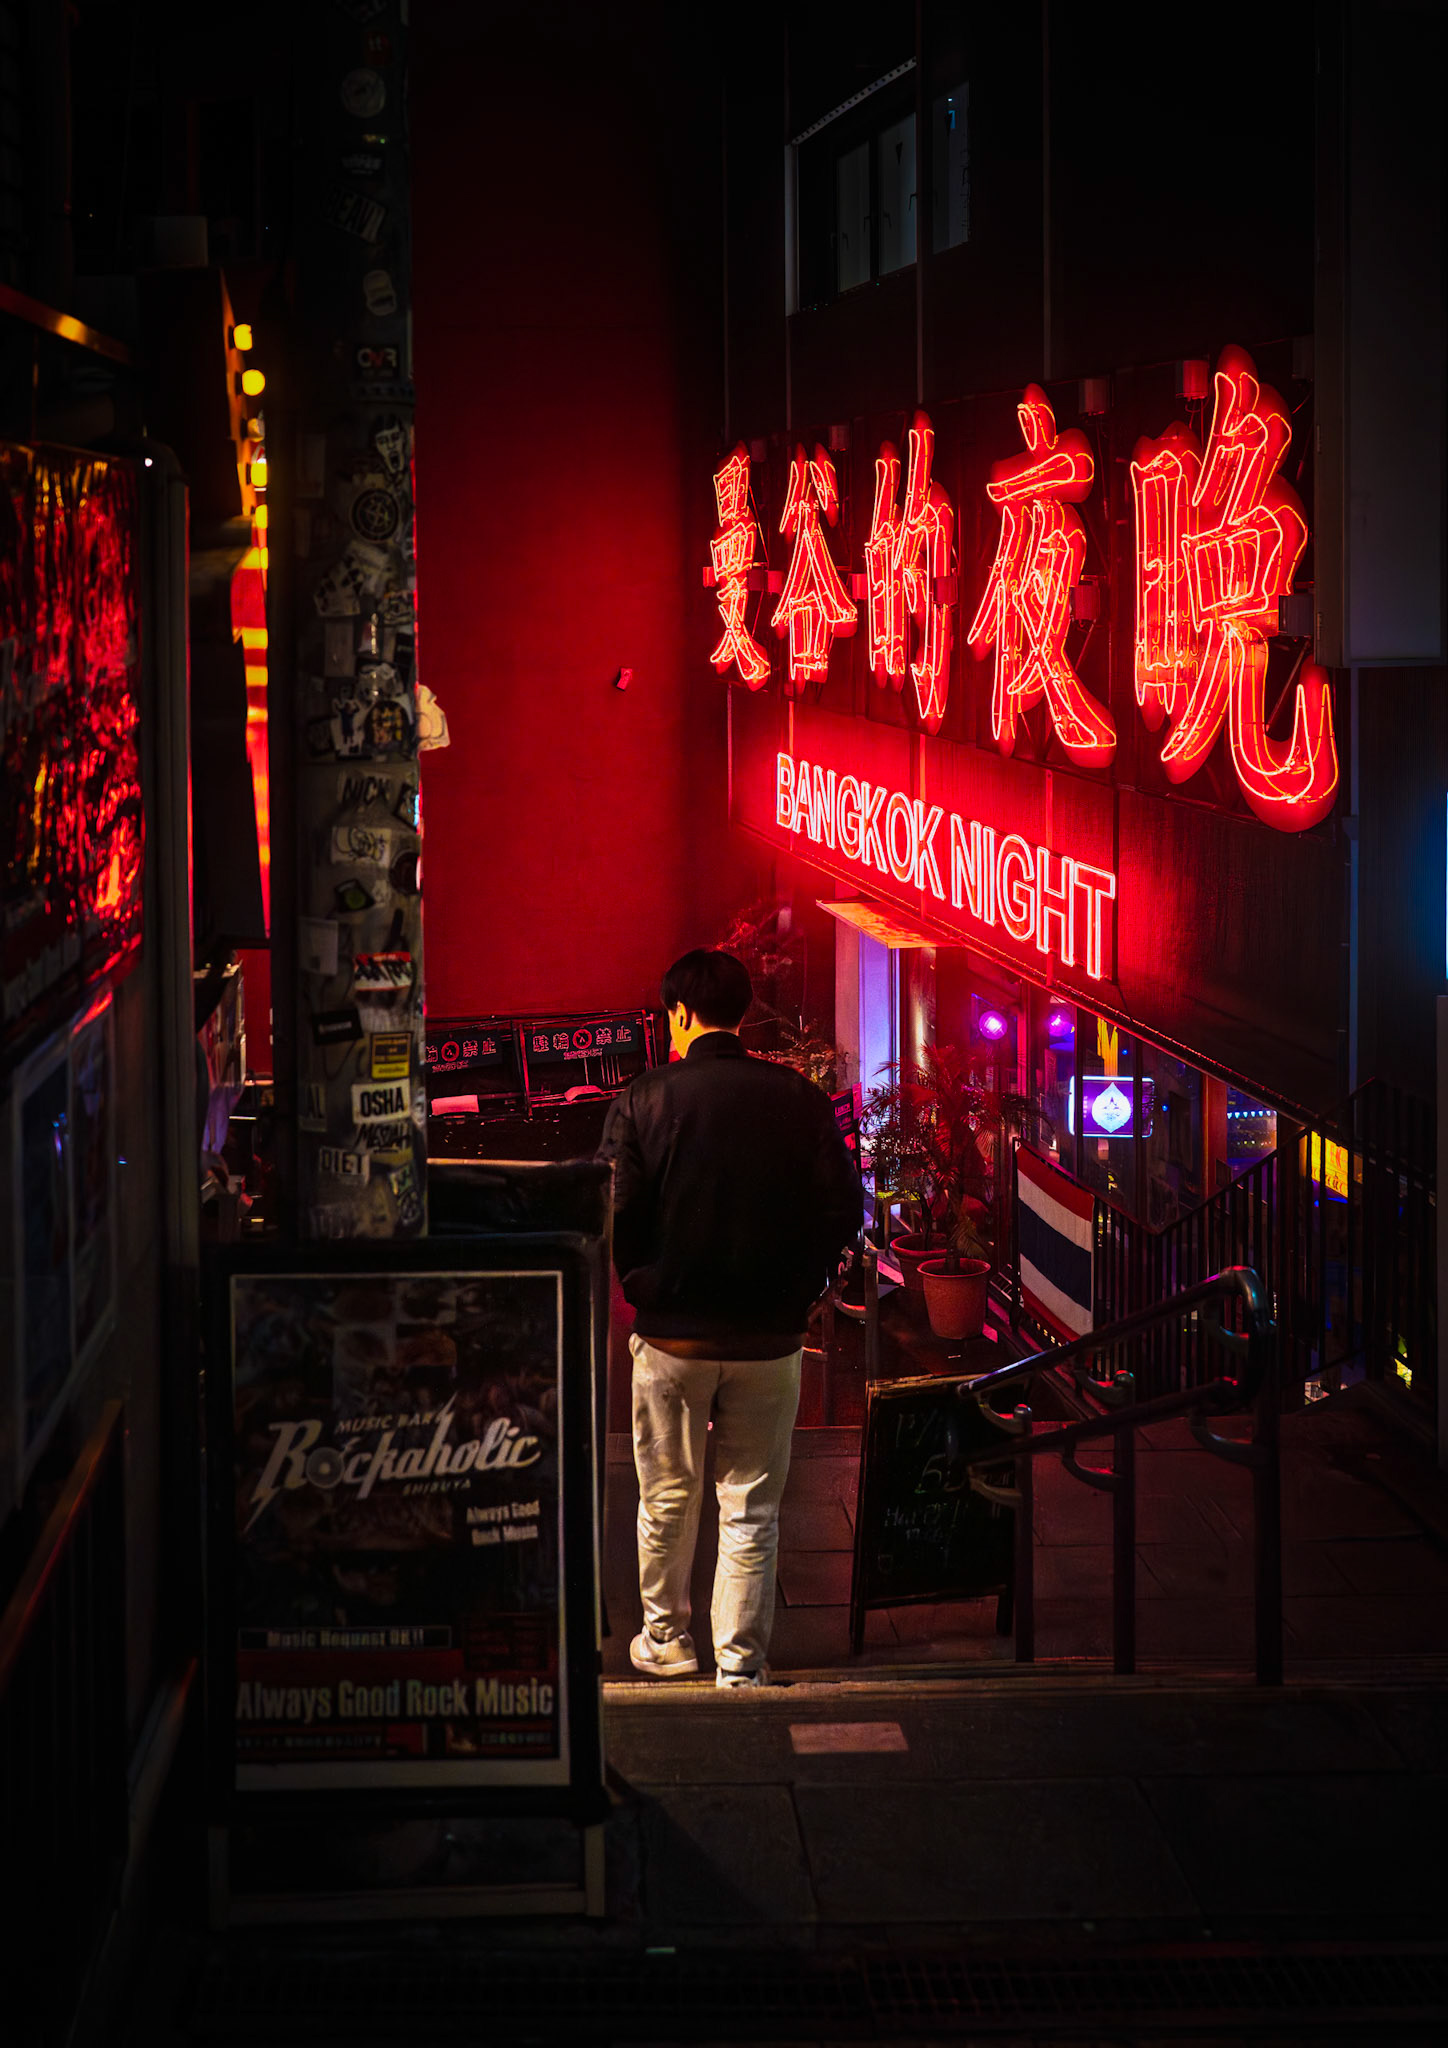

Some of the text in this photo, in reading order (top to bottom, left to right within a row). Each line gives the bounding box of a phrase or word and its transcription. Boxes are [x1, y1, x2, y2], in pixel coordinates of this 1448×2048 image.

[709, 345, 1339, 830] 曼谷的夜晚
[776, 752, 1116, 981] BANGKOK NIGHT
[360, 1086, 405, 1118] OSHA
[244, 1392, 541, 1531] Rockaholic
[334, 1414, 393, 1434] MUSIC
[235, 1676, 554, 1724] Always Good Rock Music
